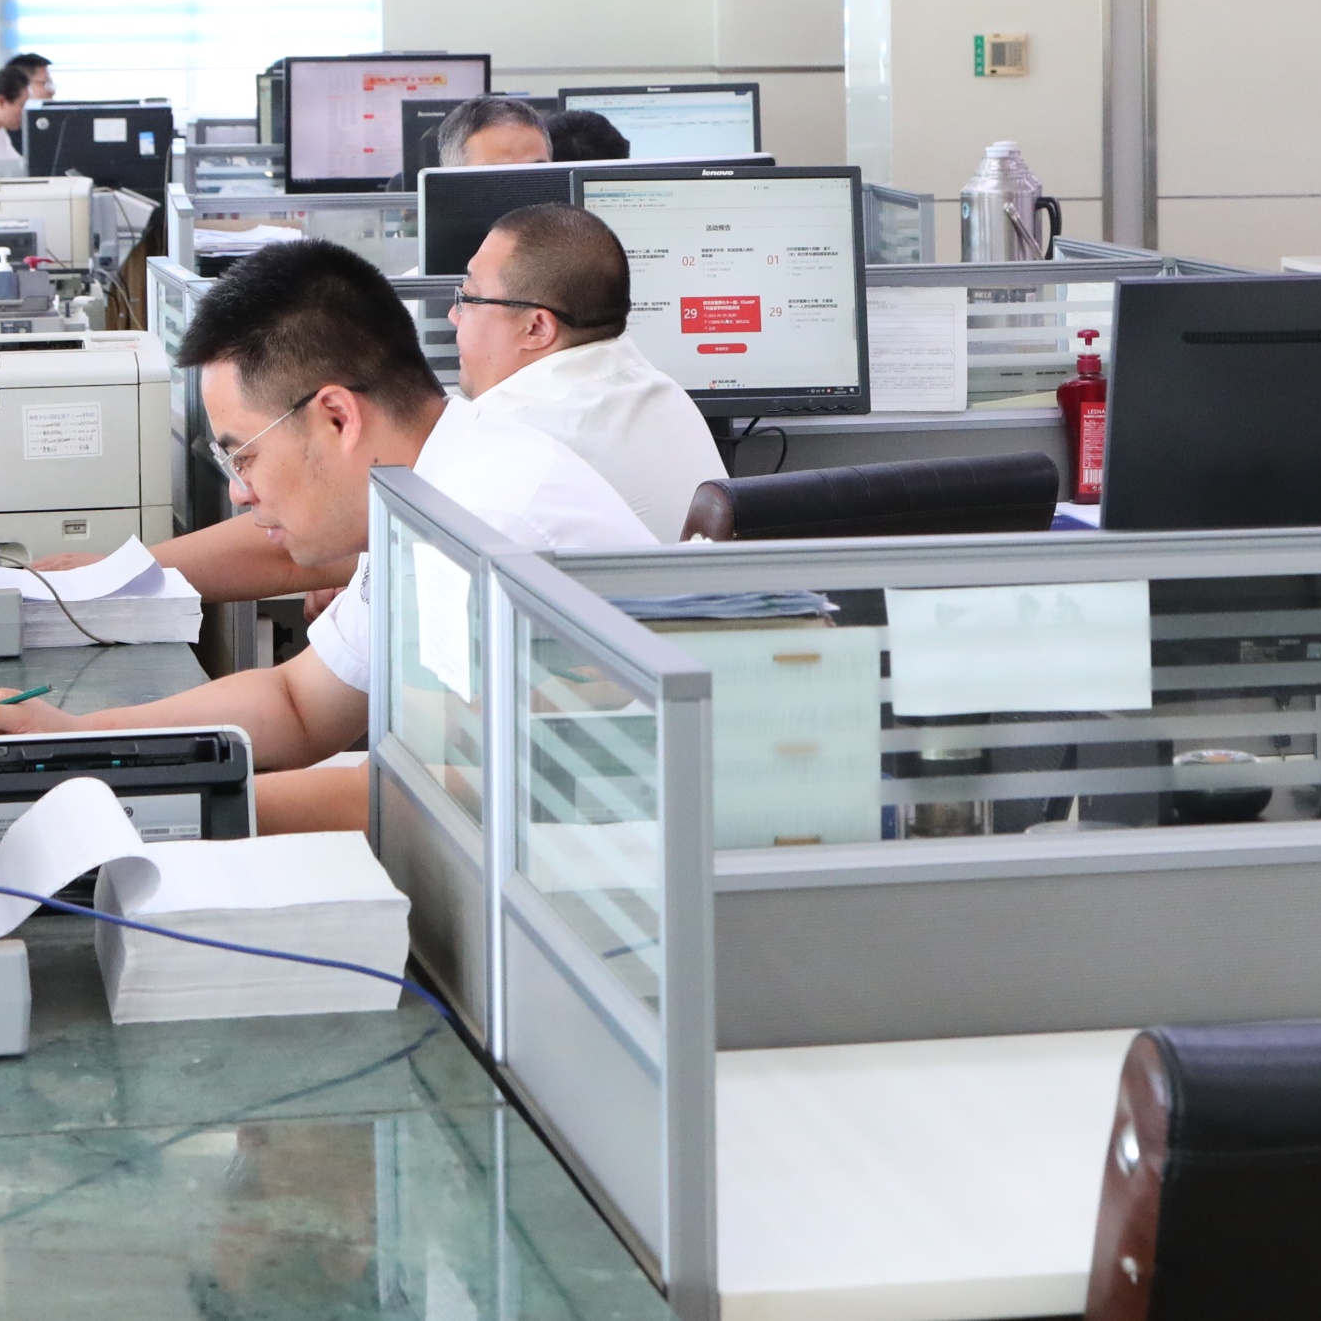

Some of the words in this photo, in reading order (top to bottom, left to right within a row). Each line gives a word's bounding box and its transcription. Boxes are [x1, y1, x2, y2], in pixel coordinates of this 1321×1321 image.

[701, 169, 734, 177] lenovo
[681, 256, 696, 267] 02
[767, 254, 780, 265] 01
[683, 308, 698, 319] 29
[769, 307, 783, 317] 29
